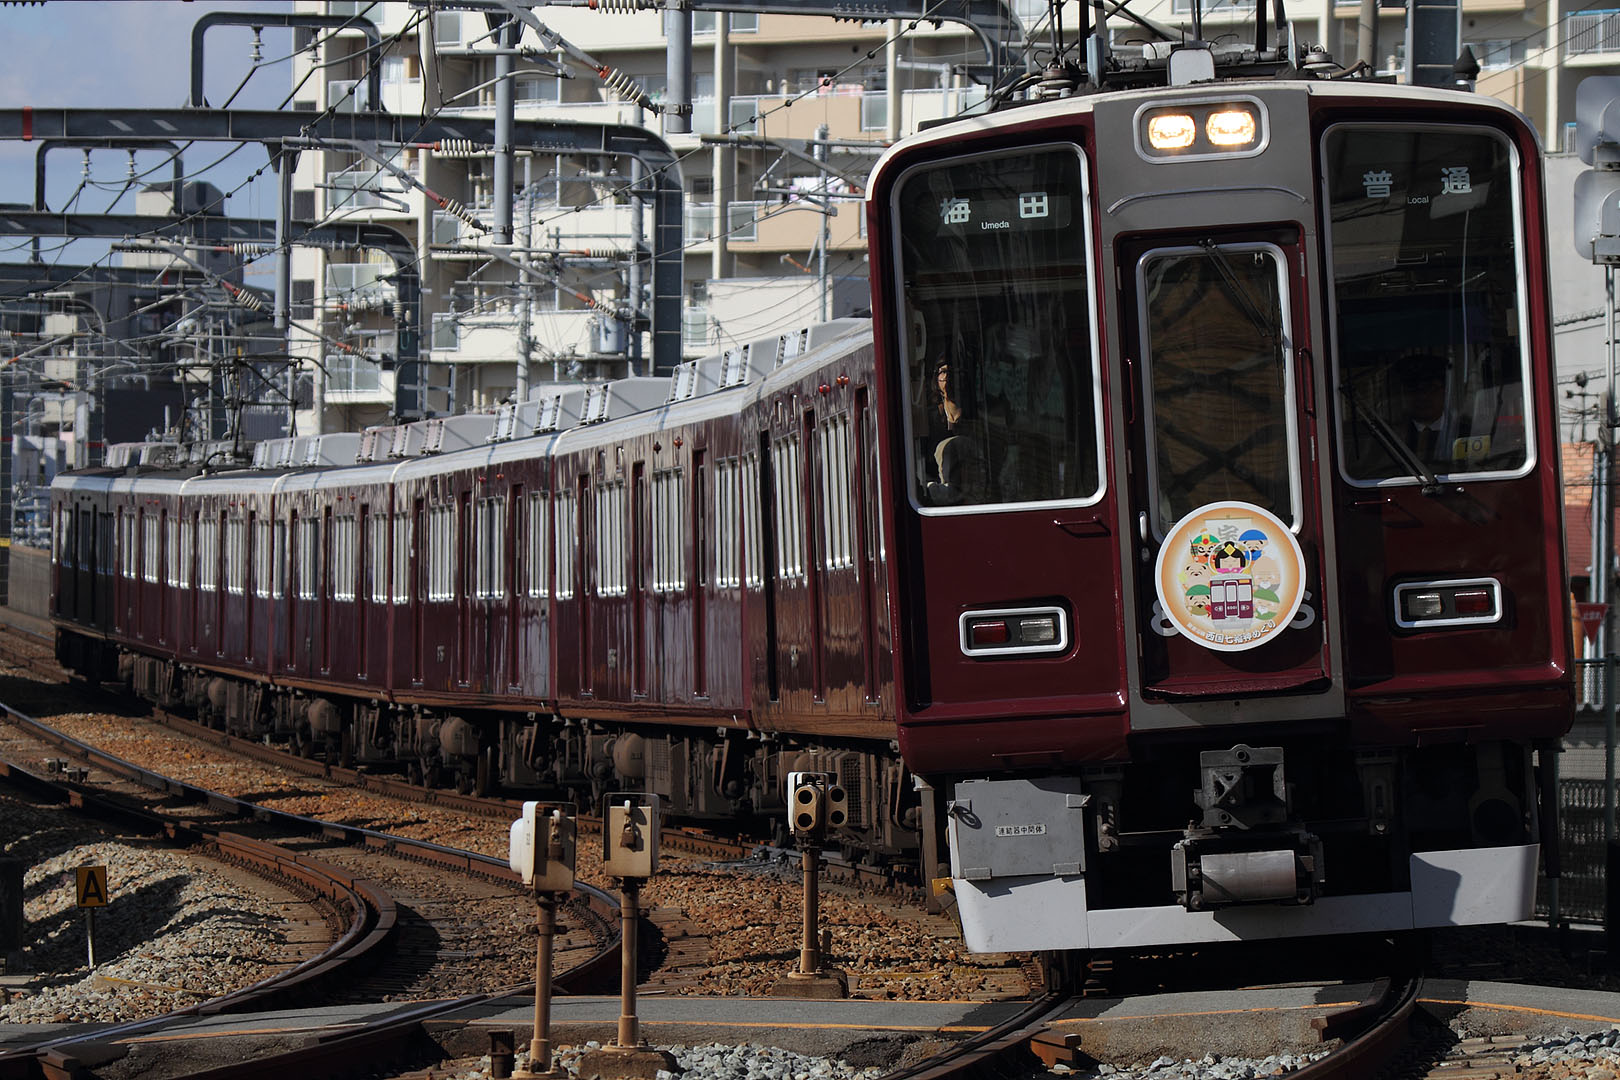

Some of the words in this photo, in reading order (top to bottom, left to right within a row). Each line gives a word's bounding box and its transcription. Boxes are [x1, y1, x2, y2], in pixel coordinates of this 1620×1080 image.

[1407, 195, 1429, 204] Local
[981, 220, 1010, 230] Umeda
[82, 871, 104, 903] A
